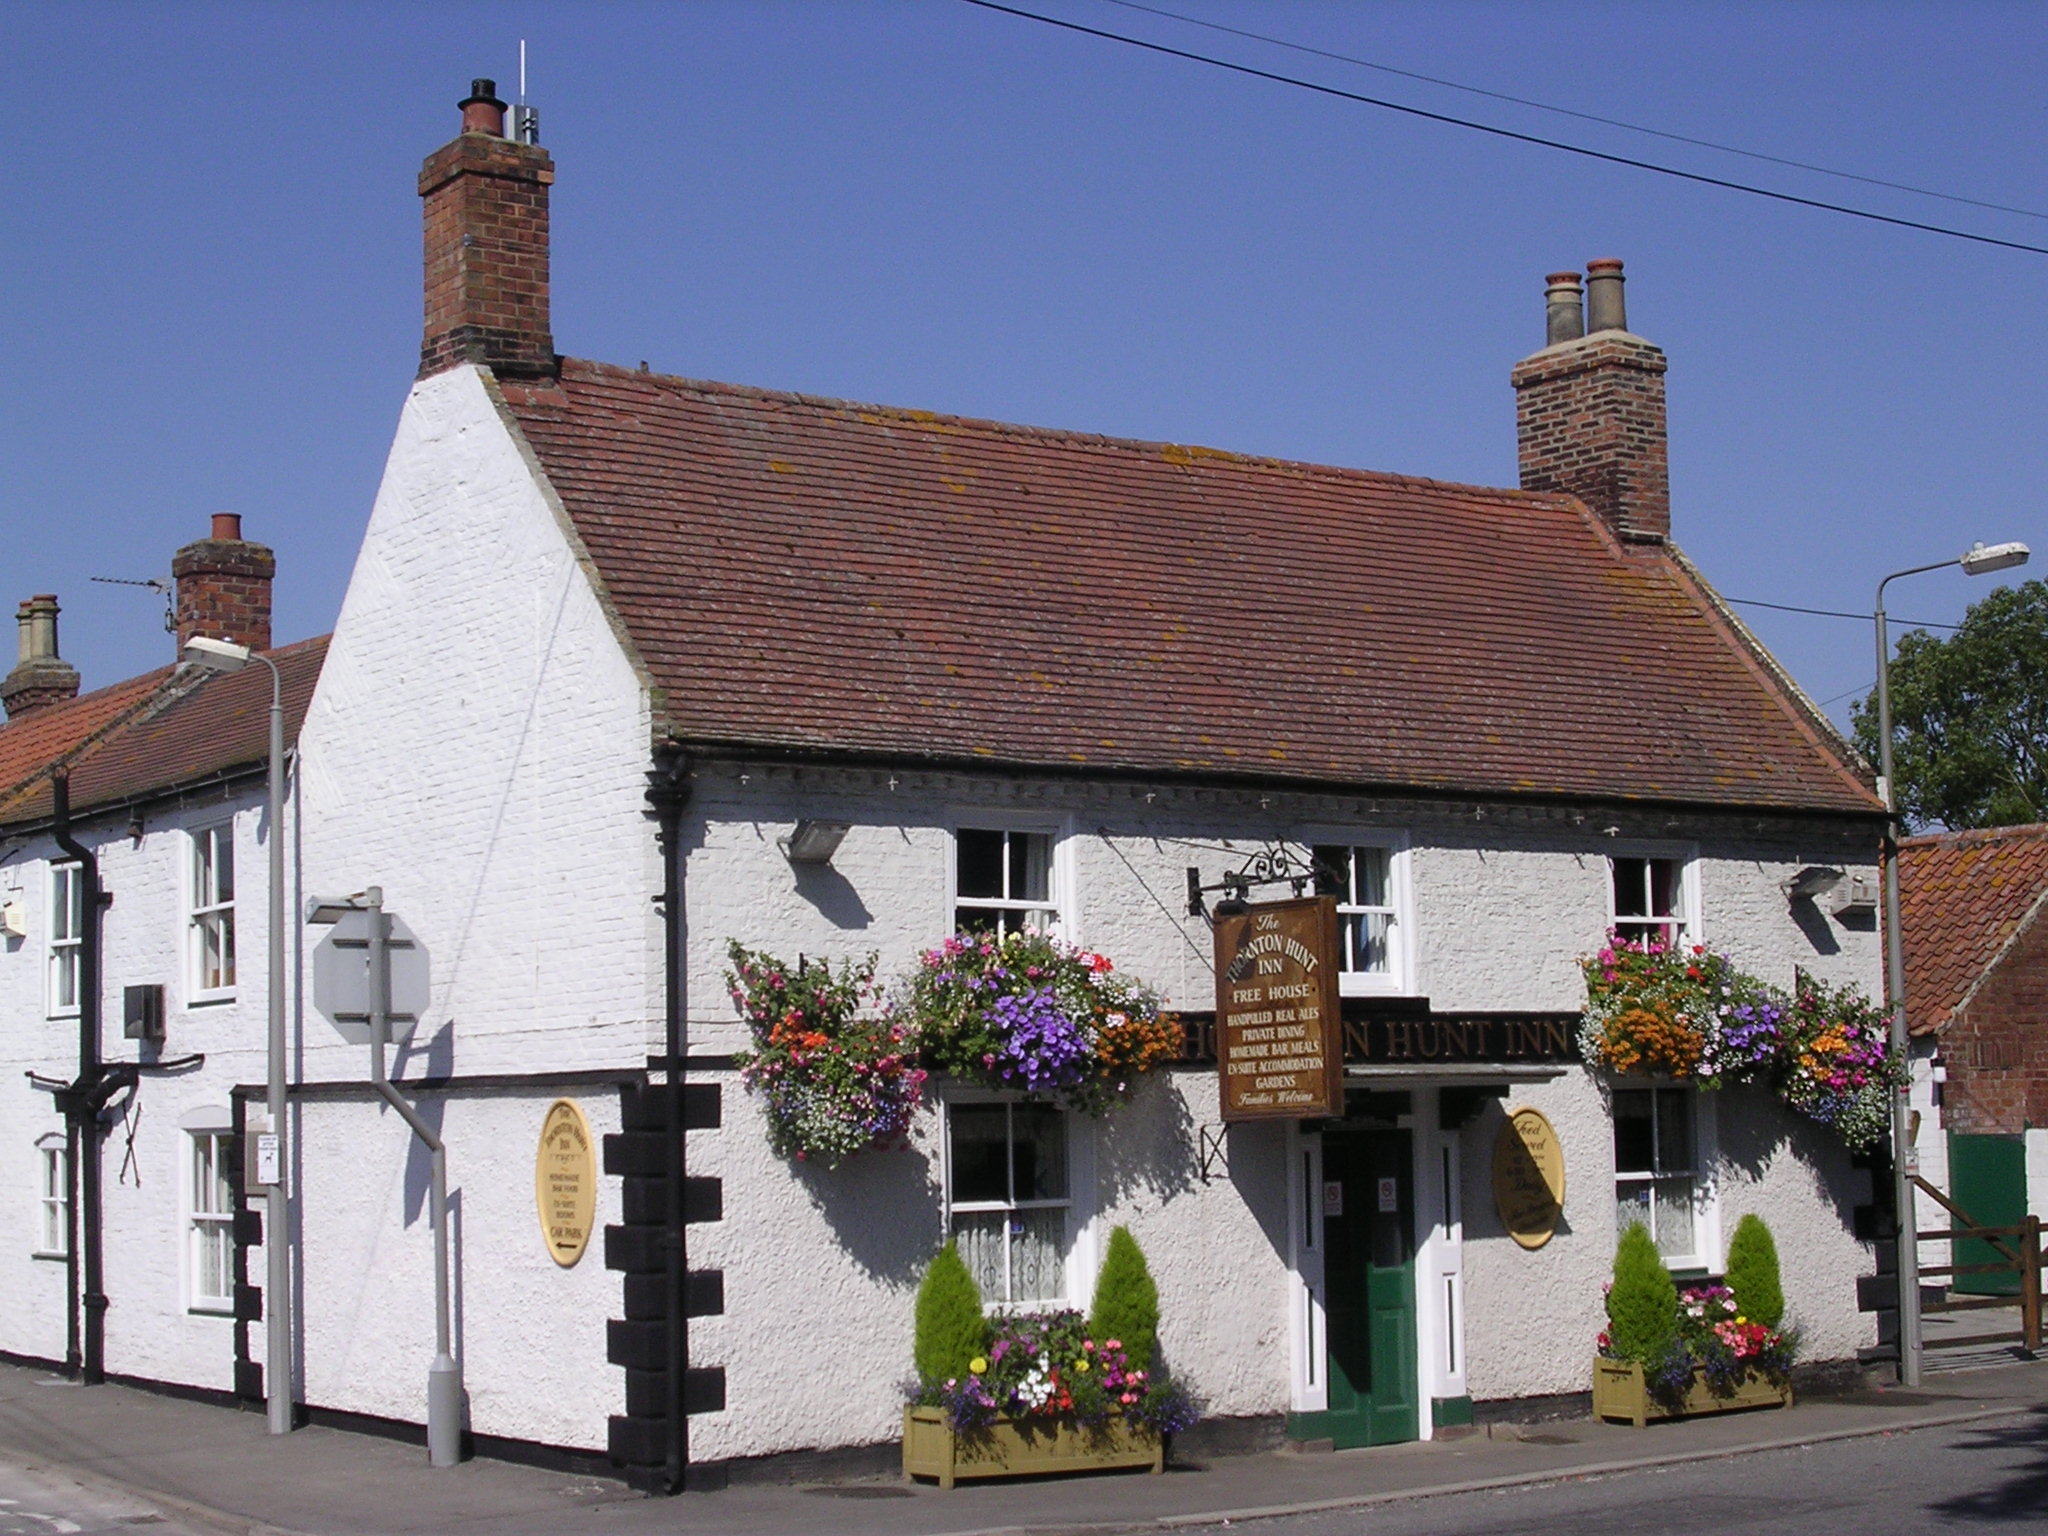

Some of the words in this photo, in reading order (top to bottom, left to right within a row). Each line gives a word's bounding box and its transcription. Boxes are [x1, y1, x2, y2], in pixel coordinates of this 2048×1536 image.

[1256, 913, 1280, 931] The
[1225, 934, 1283, 984] THORNTON
[1284, 938, 1318, 973] HUNT
[1258, 958, 1283, 975] INN
[1233, 988, 1262, 1003] FREE
[1268, 984, 1310, 1000] HOUSE
[1227, 1011, 1273, 1027] HANDPULLED
[1275, 1010, 1296, 1021] REAL
[1298, 1007, 1319, 1020] ALES
[1242, 1027, 1275, 1041] PRIVATE
[1277, 1025, 1305, 1038] DINING
[1386, 1020, 1492, 1057] HUNT
[1505, 1020, 1569, 1056] INN
[1229, 1044, 1269, 1058] HOMEMADE
[1271, 1043, 1289, 1056] BAR
[1291, 1041, 1319, 1054] MEALS
[1227, 1061, 1257, 1075] EN-SUITE
[1259, 1057, 1324, 1073] ACCOMMODATION
[1255, 1075, 1297, 1089] GARDENS
[1238, 1092, 1274, 1106] Families
[1277, 1090, 1314, 1104] Welcome
